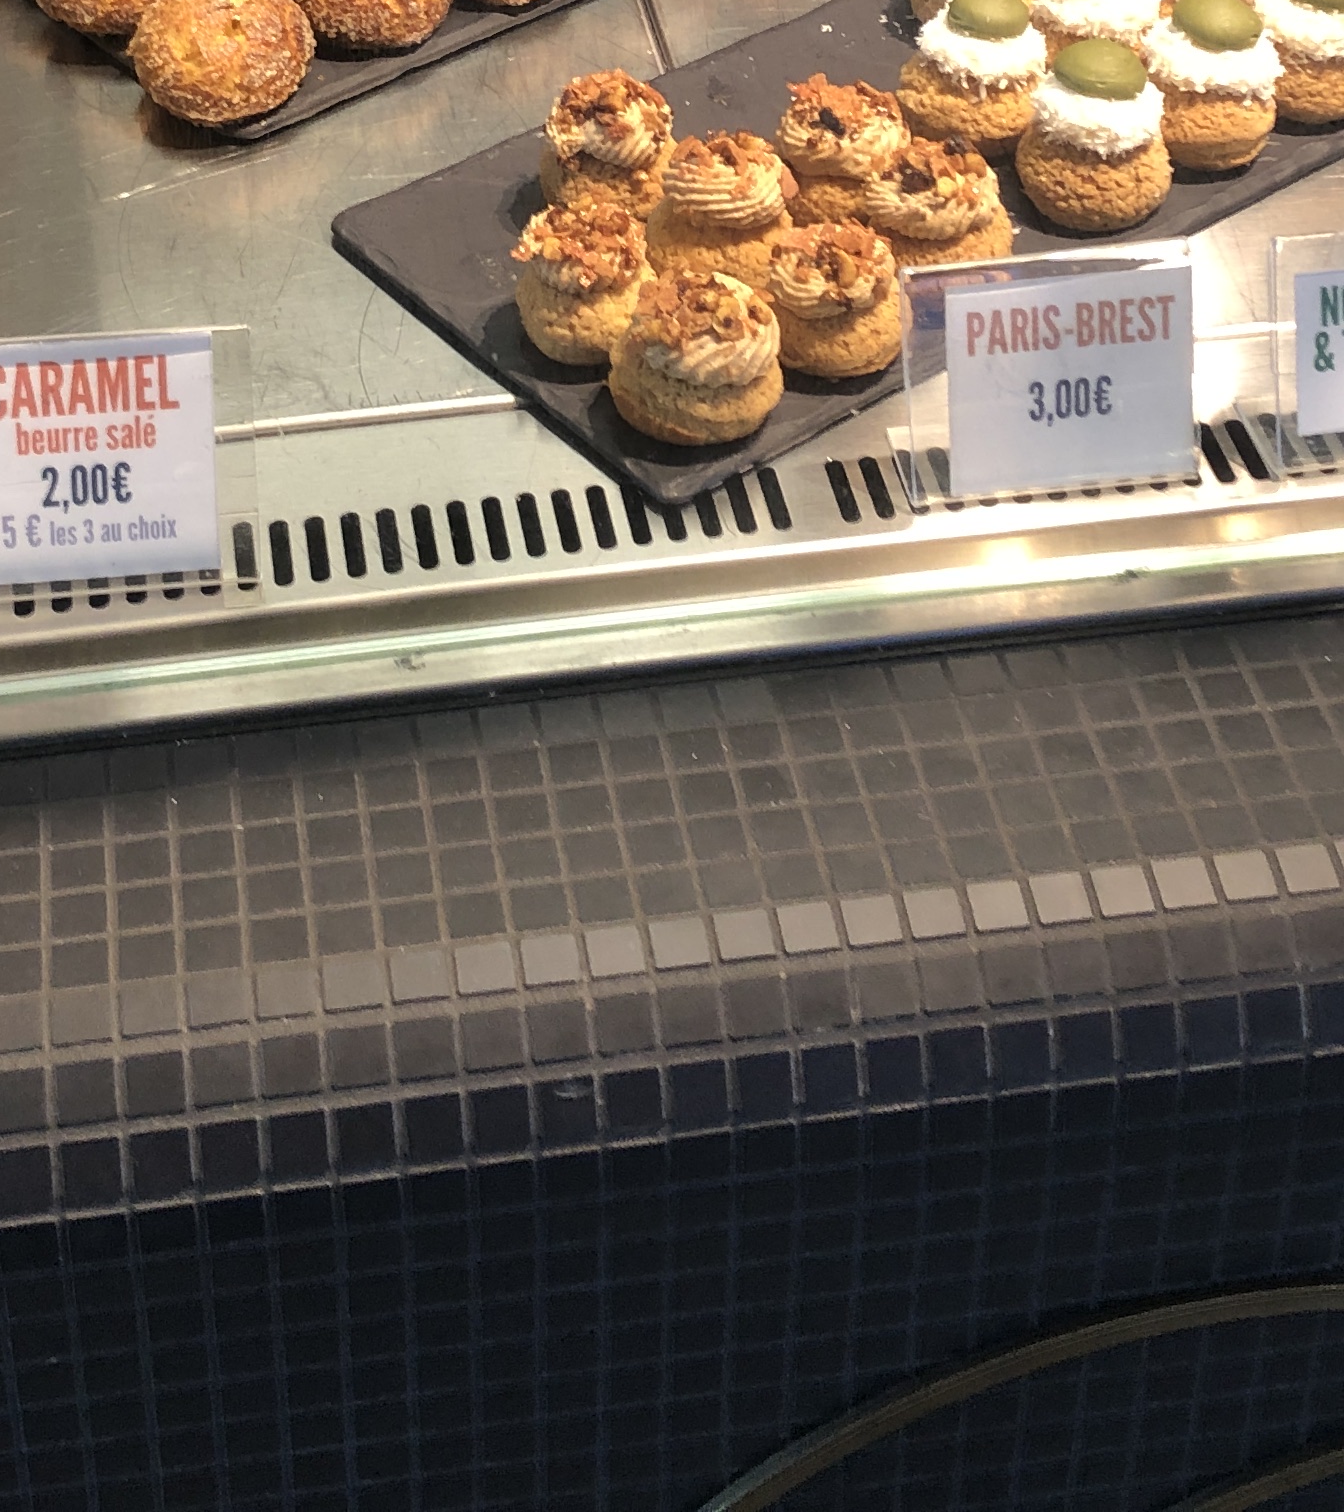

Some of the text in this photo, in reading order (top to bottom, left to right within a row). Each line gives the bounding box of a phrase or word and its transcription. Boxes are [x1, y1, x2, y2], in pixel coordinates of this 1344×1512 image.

[966, 295, 1176, 357] PARIS-BREST
[1314, 331, 1335, 372] &
[1029, 375, 1113, 427] 3,00€
[15, 415, 157, 456] beurre salé
[41, 461, 132, 514] 2,00€
[2, 513, 177, 549] 5 € les 3 au choix
